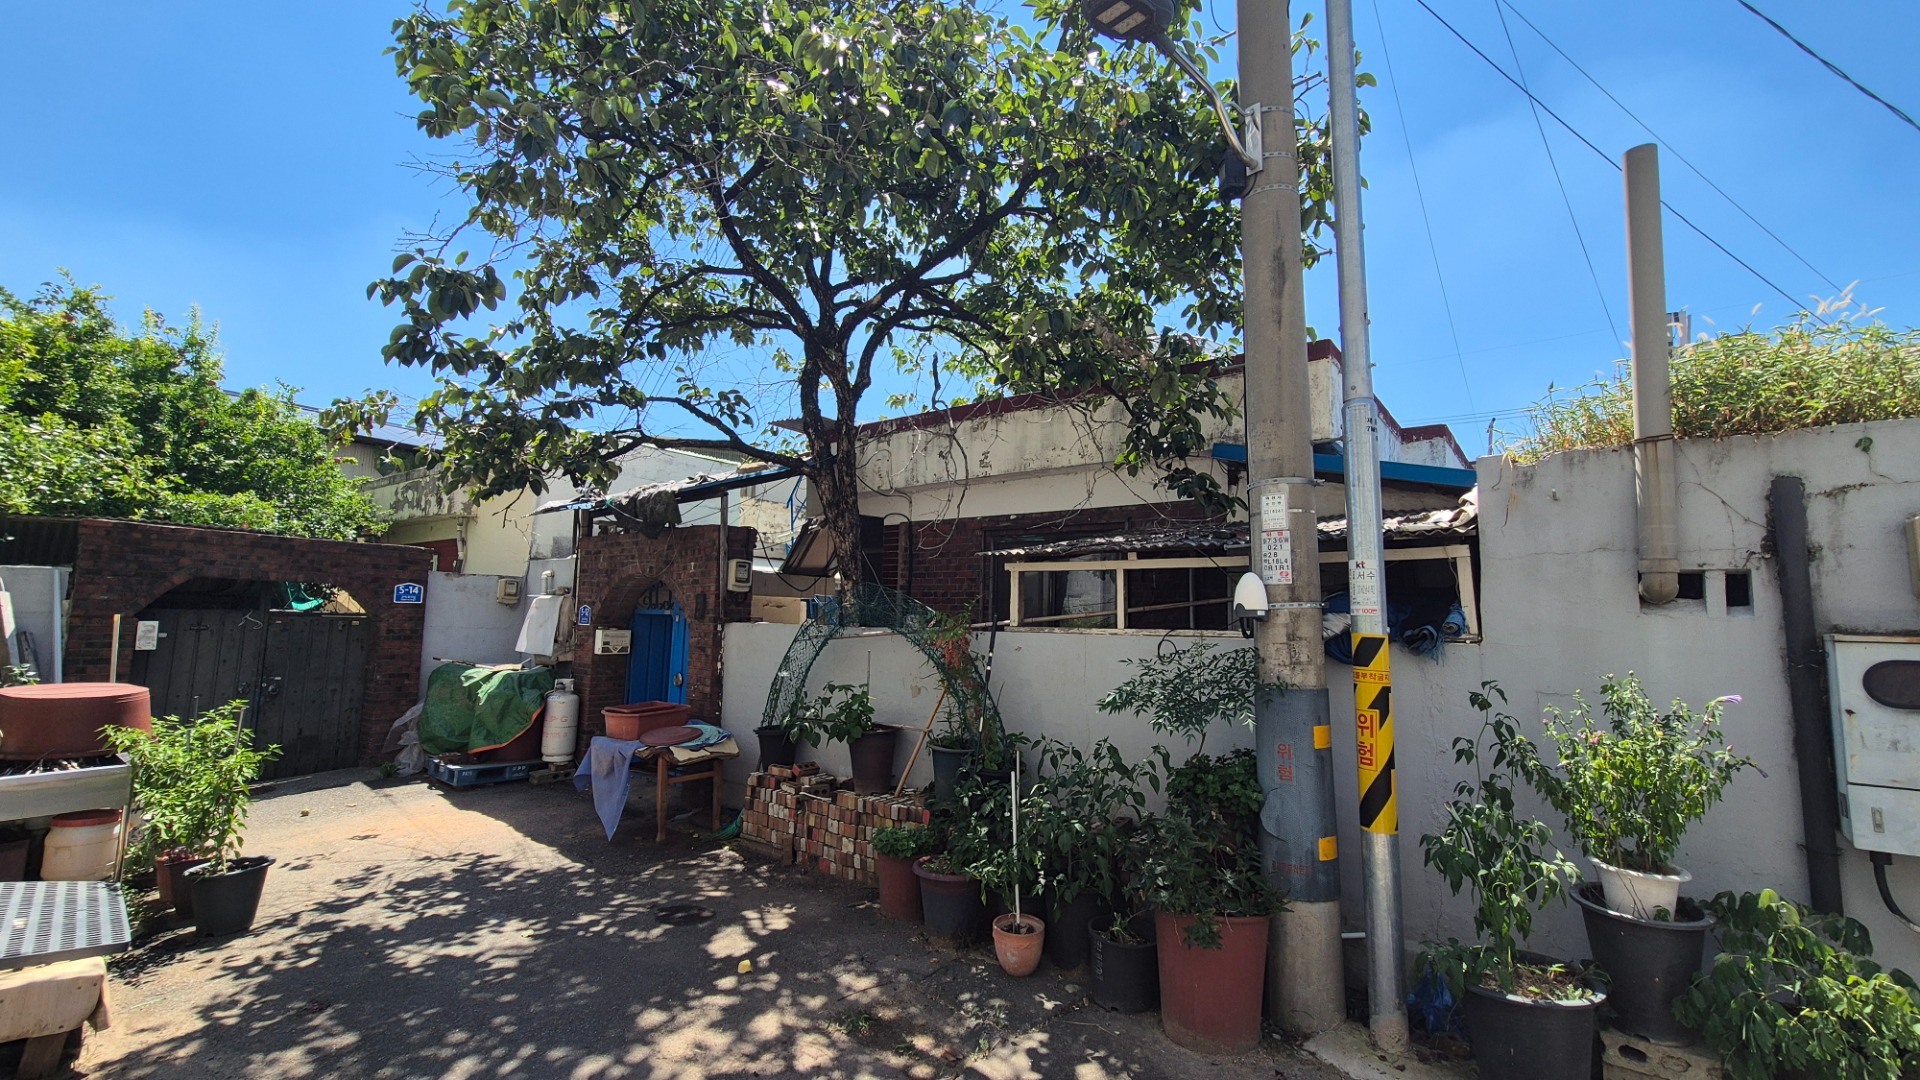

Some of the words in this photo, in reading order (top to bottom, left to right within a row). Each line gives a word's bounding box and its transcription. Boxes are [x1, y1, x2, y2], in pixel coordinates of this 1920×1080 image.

[1355, 561, 1366, 569] kt
[1357, 571, 1376, 580] 서수
[1358, 713, 1374, 767] 위험
[1276, 743, 1294, 782] 위험
